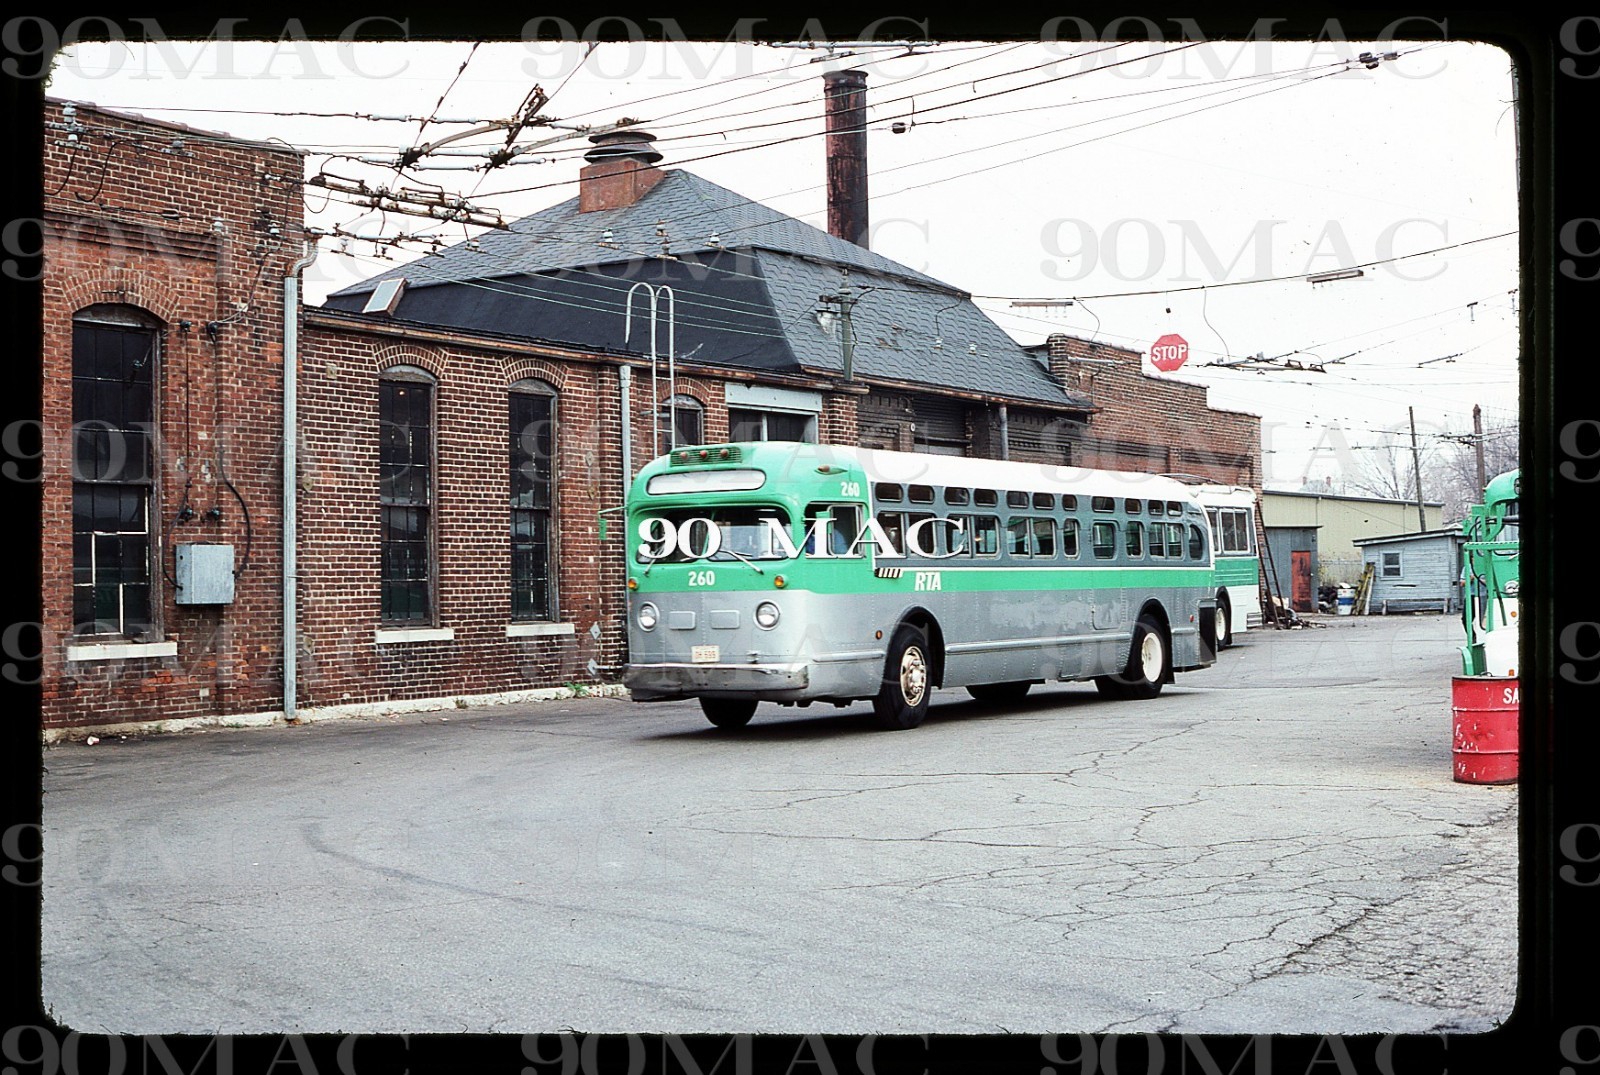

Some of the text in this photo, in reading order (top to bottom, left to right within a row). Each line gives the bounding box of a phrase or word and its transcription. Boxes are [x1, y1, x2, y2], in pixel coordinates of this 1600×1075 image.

[1151, 344, 1187, 362] STOP
[841, 482, 860, 497] 260
[688, 571, 715, 586] 260
[914, 572, 942, 591] RTA
